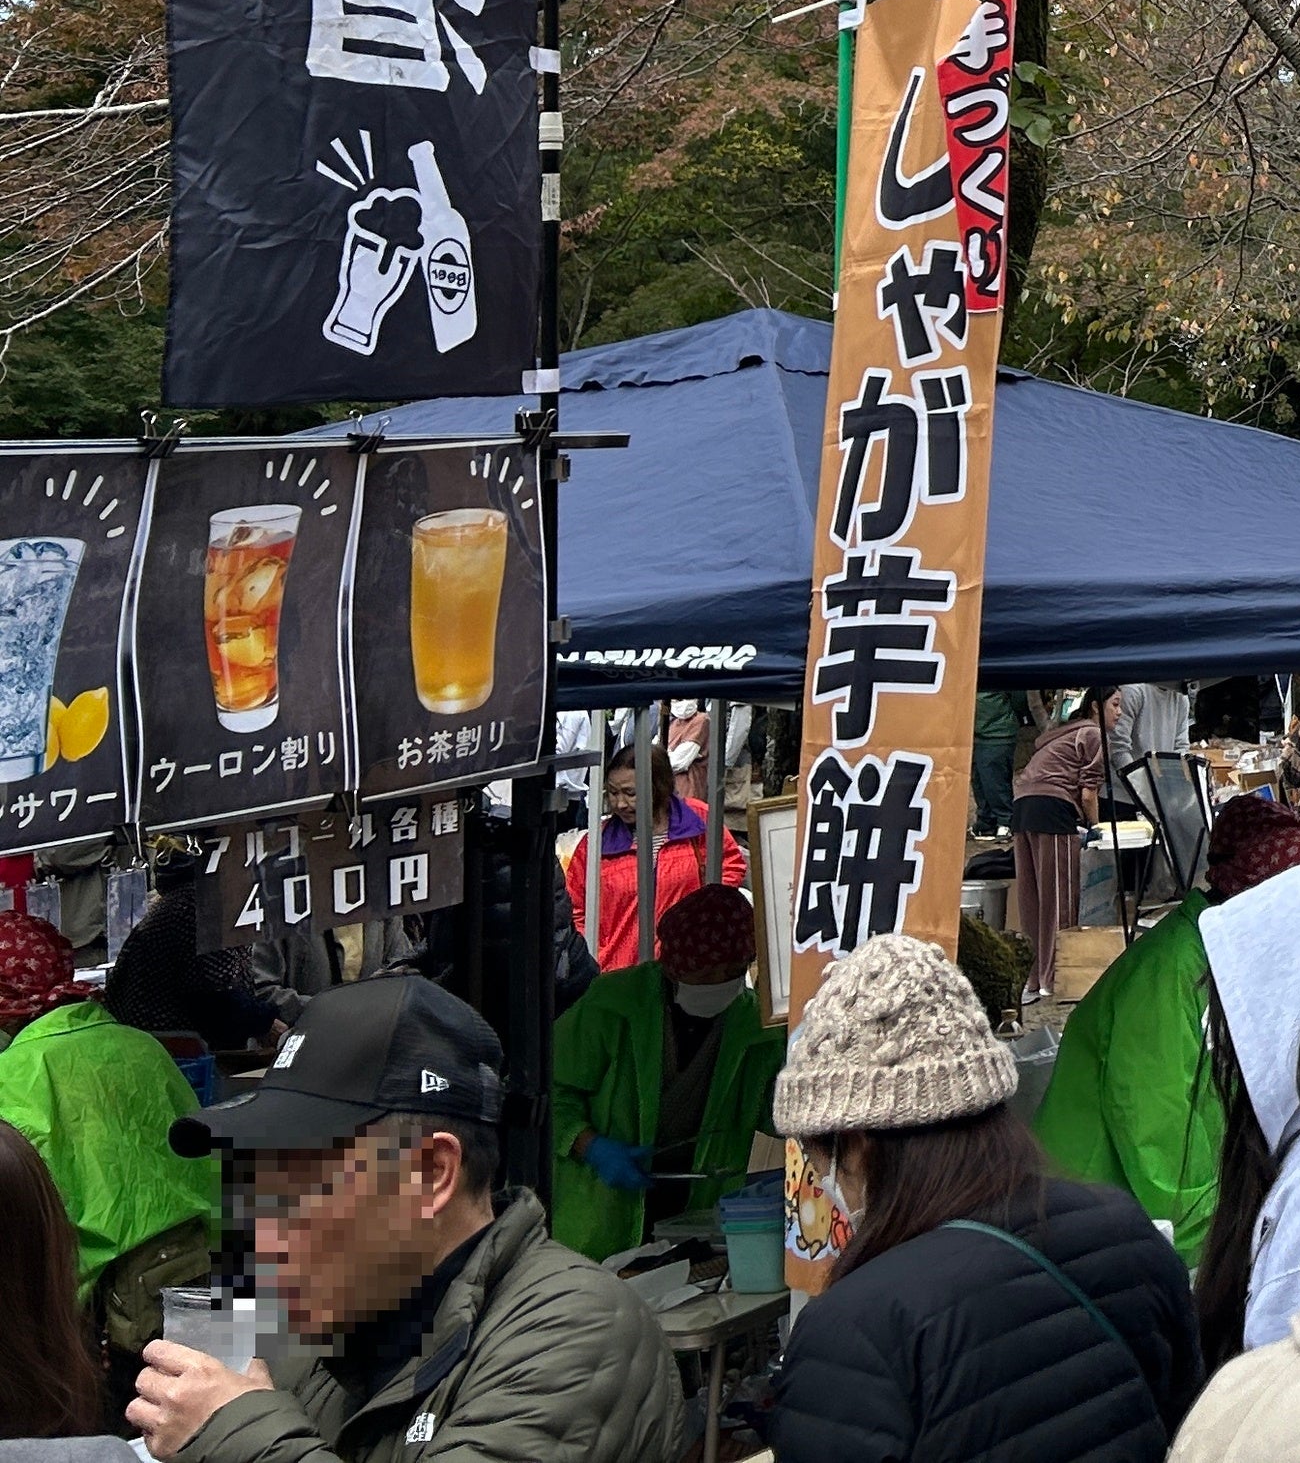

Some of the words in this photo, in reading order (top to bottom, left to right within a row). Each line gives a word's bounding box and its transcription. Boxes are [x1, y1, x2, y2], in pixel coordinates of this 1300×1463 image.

[796, 67, 968, 954] しゃが芋餅
[150, 731, 337, 793] ウーロン割り
[397, 720, 507, 770] お茶割り
[234, 852, 430, 932] 400円
